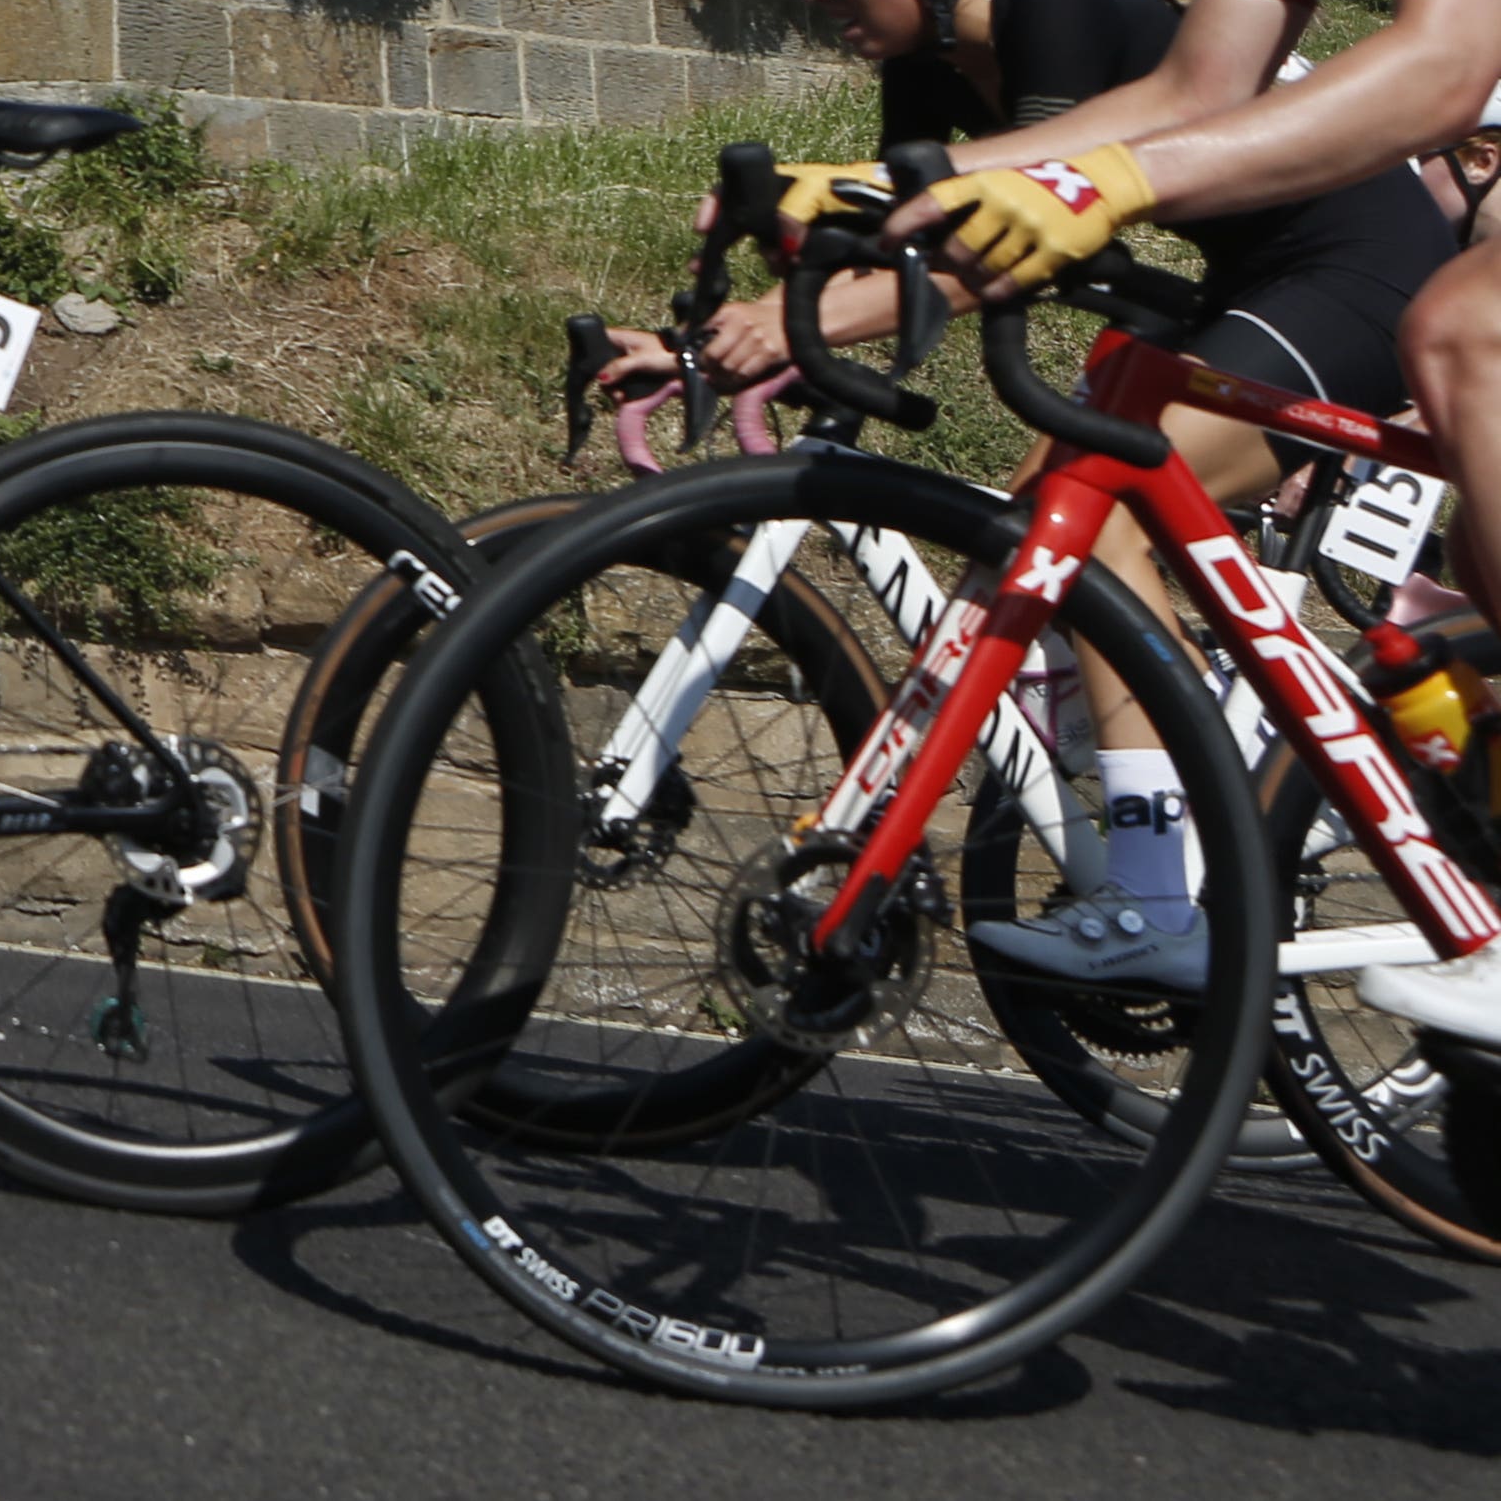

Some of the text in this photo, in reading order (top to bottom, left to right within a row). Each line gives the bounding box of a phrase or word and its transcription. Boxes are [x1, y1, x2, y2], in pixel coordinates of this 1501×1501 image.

[1343, 472, 1423, 560] 115
[1185, 534, 1501, 941] DARE
[1289, 1052, 1391, 1164] SWISS
[482, 1214, 525, 1250] DT
[515, 1245, 582, 1302] SWISS
